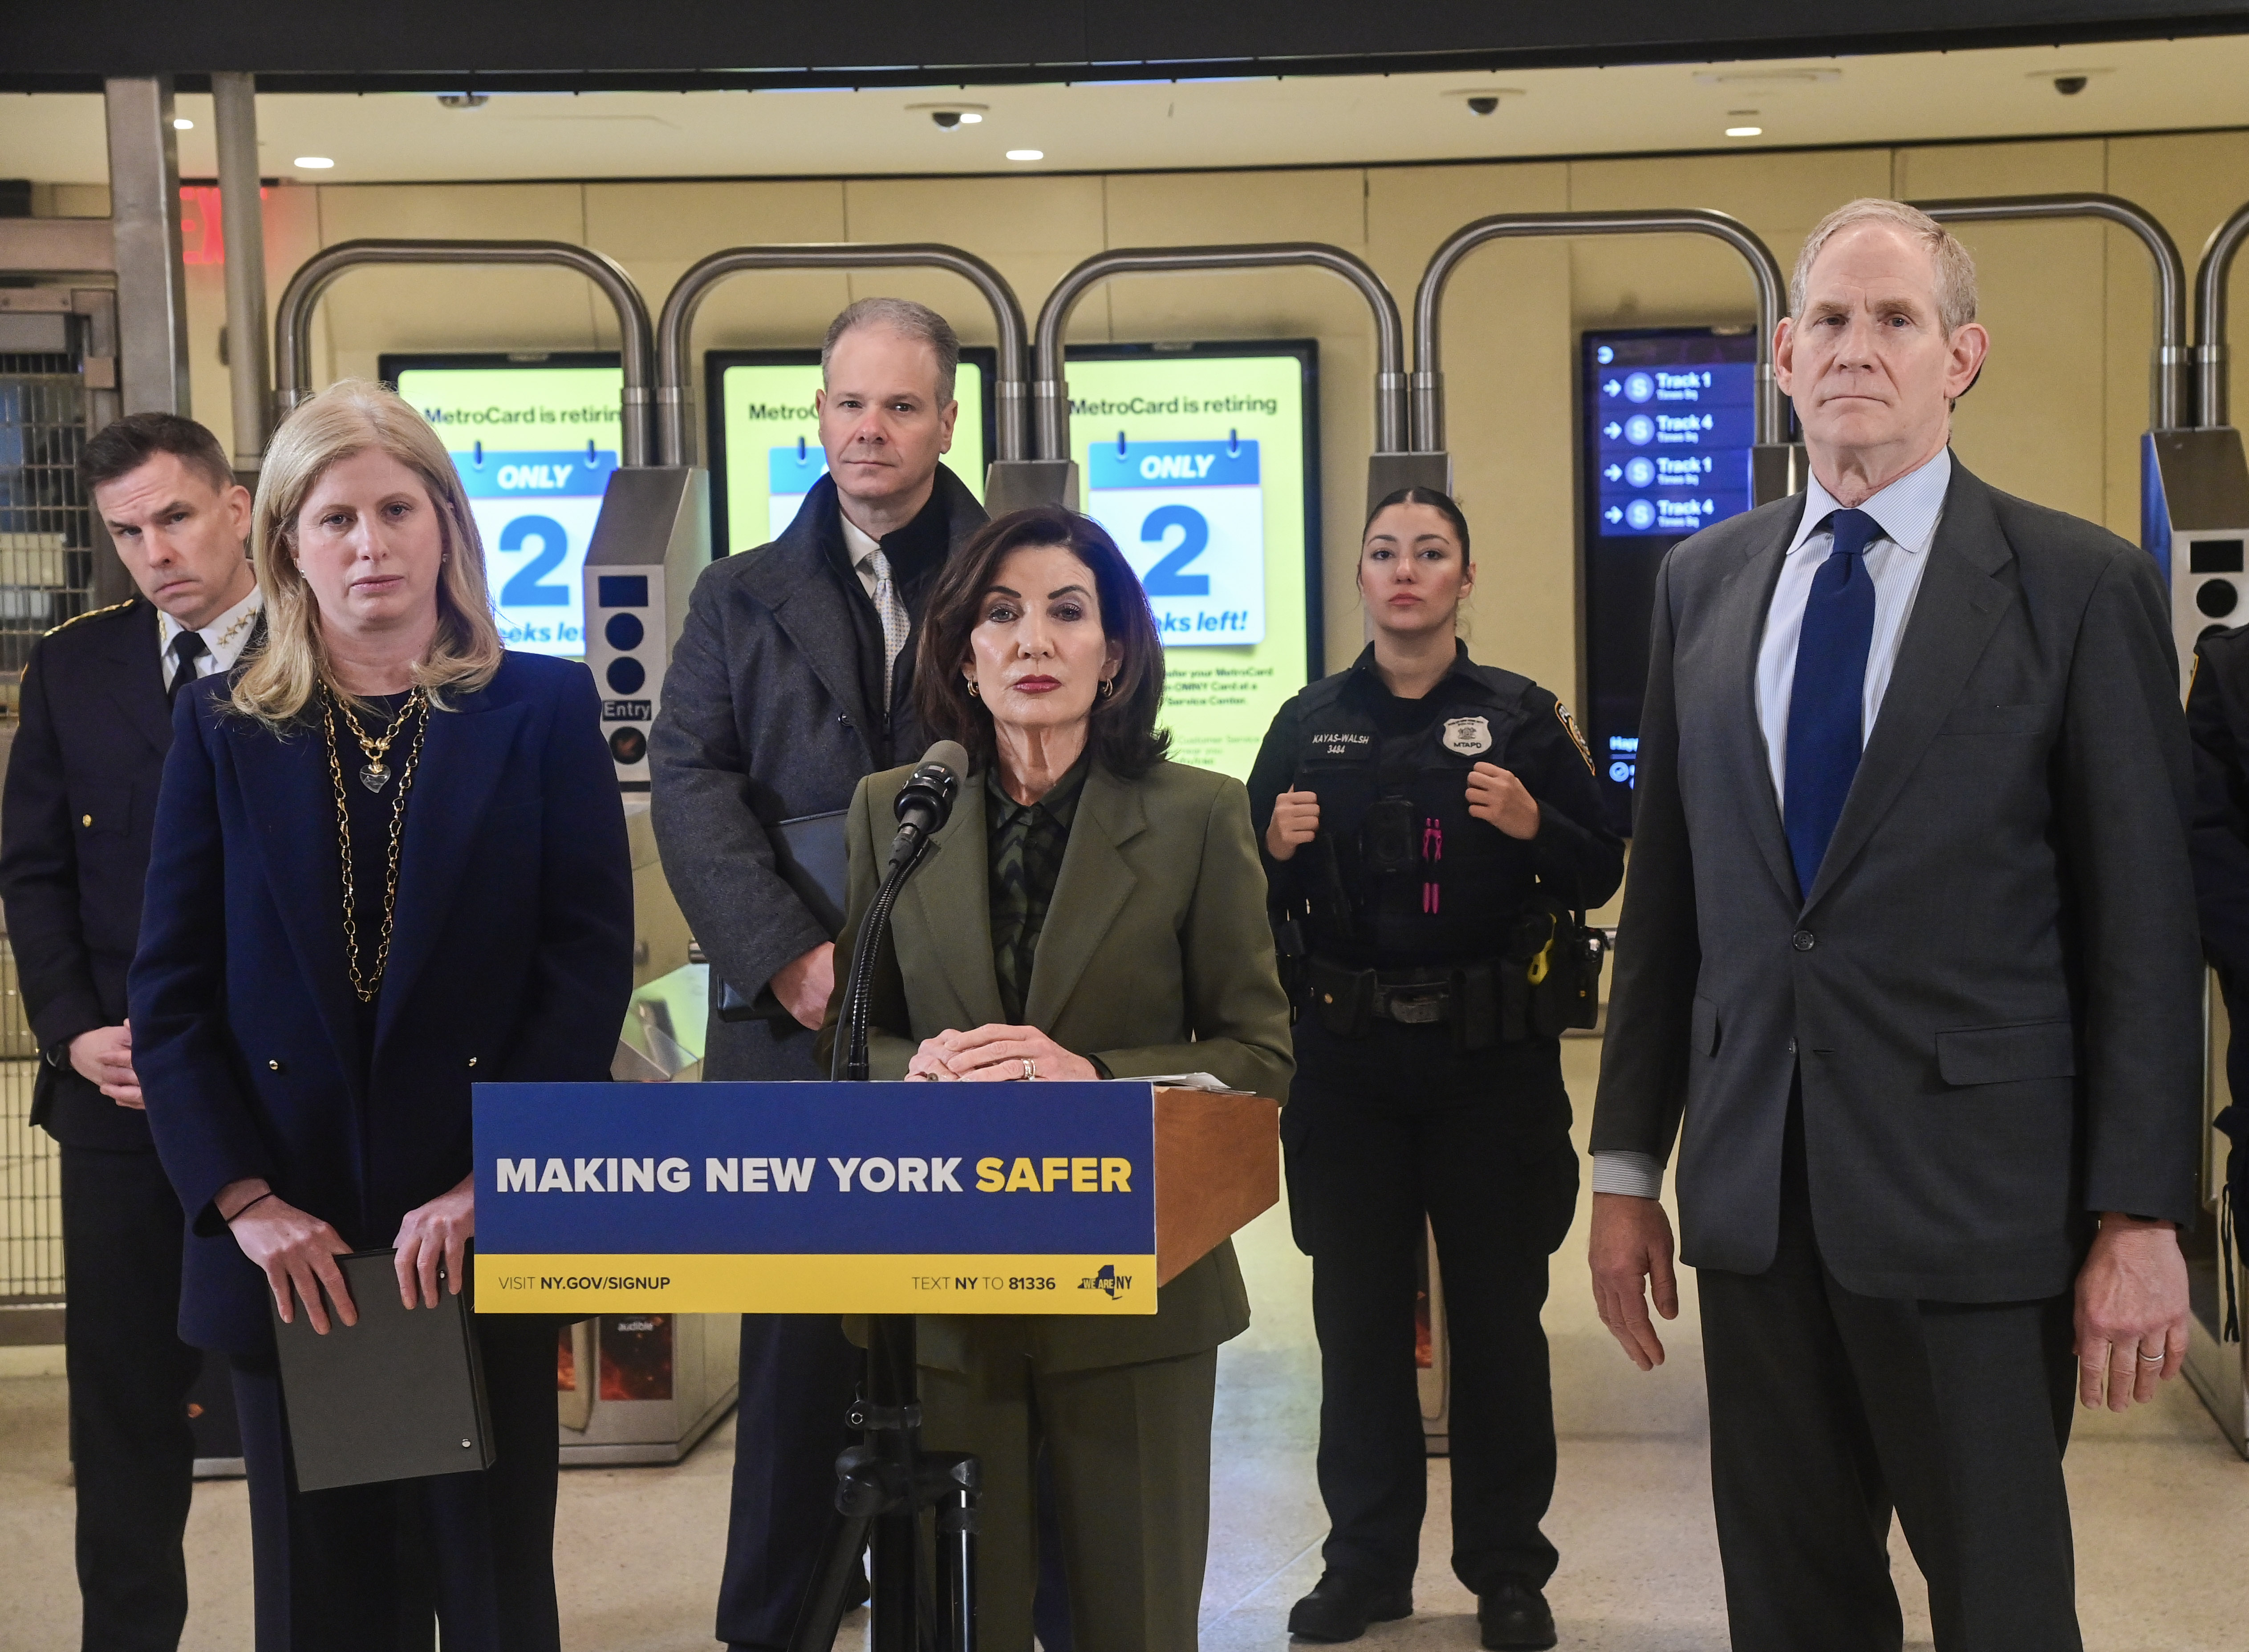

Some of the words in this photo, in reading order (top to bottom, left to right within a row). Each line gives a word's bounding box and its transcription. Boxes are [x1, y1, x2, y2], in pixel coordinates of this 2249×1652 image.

[425, 406, 535, 424] MetroCard
[540, 405, 556, 423] is
[561, 404, 621, 423] retirin
[749, 403, 818, 420] MetroC
[1070, 397, 1178, 415] MetroCard
[1184, 397, 1199, 413] is
[1204, 397, 1277, 416] retiring
[497, 464, 573, 489] ONLY
[1139, 454, 1216, 480] ONLY
[1141, 504, 1209, 596] 2
[499, 514, 569, 606] 2
[1197, 611, 1248, 632] left!
[604, 701, 650, 720] Entry
[1312, 733, 1369, 744] KAYAS-WALSH
[496, 1157, 690, 1193] MAKING
[706, 1158, 816, 1192] NEW
[827, 1157, 963, 1192] YORK
[975, 1157, 1131, 1193] SAFER
[498, 1276, 536, 1290] VISIT
[540, 1276, 670, 1290] NY.GOV/SIGNUP
[912, 1277, 950, 1290] TEXT
[955, 1277, 978, 1290] NY
[982, 1277, 1003, 1290] TO
[1008, 1277, 1056, 1290] 81336
[1083, 1279, 1096, 1289] WE
[1098, 1279, 1114, 1289] ARE
[1116, 1275, 1132, 1289] NY
